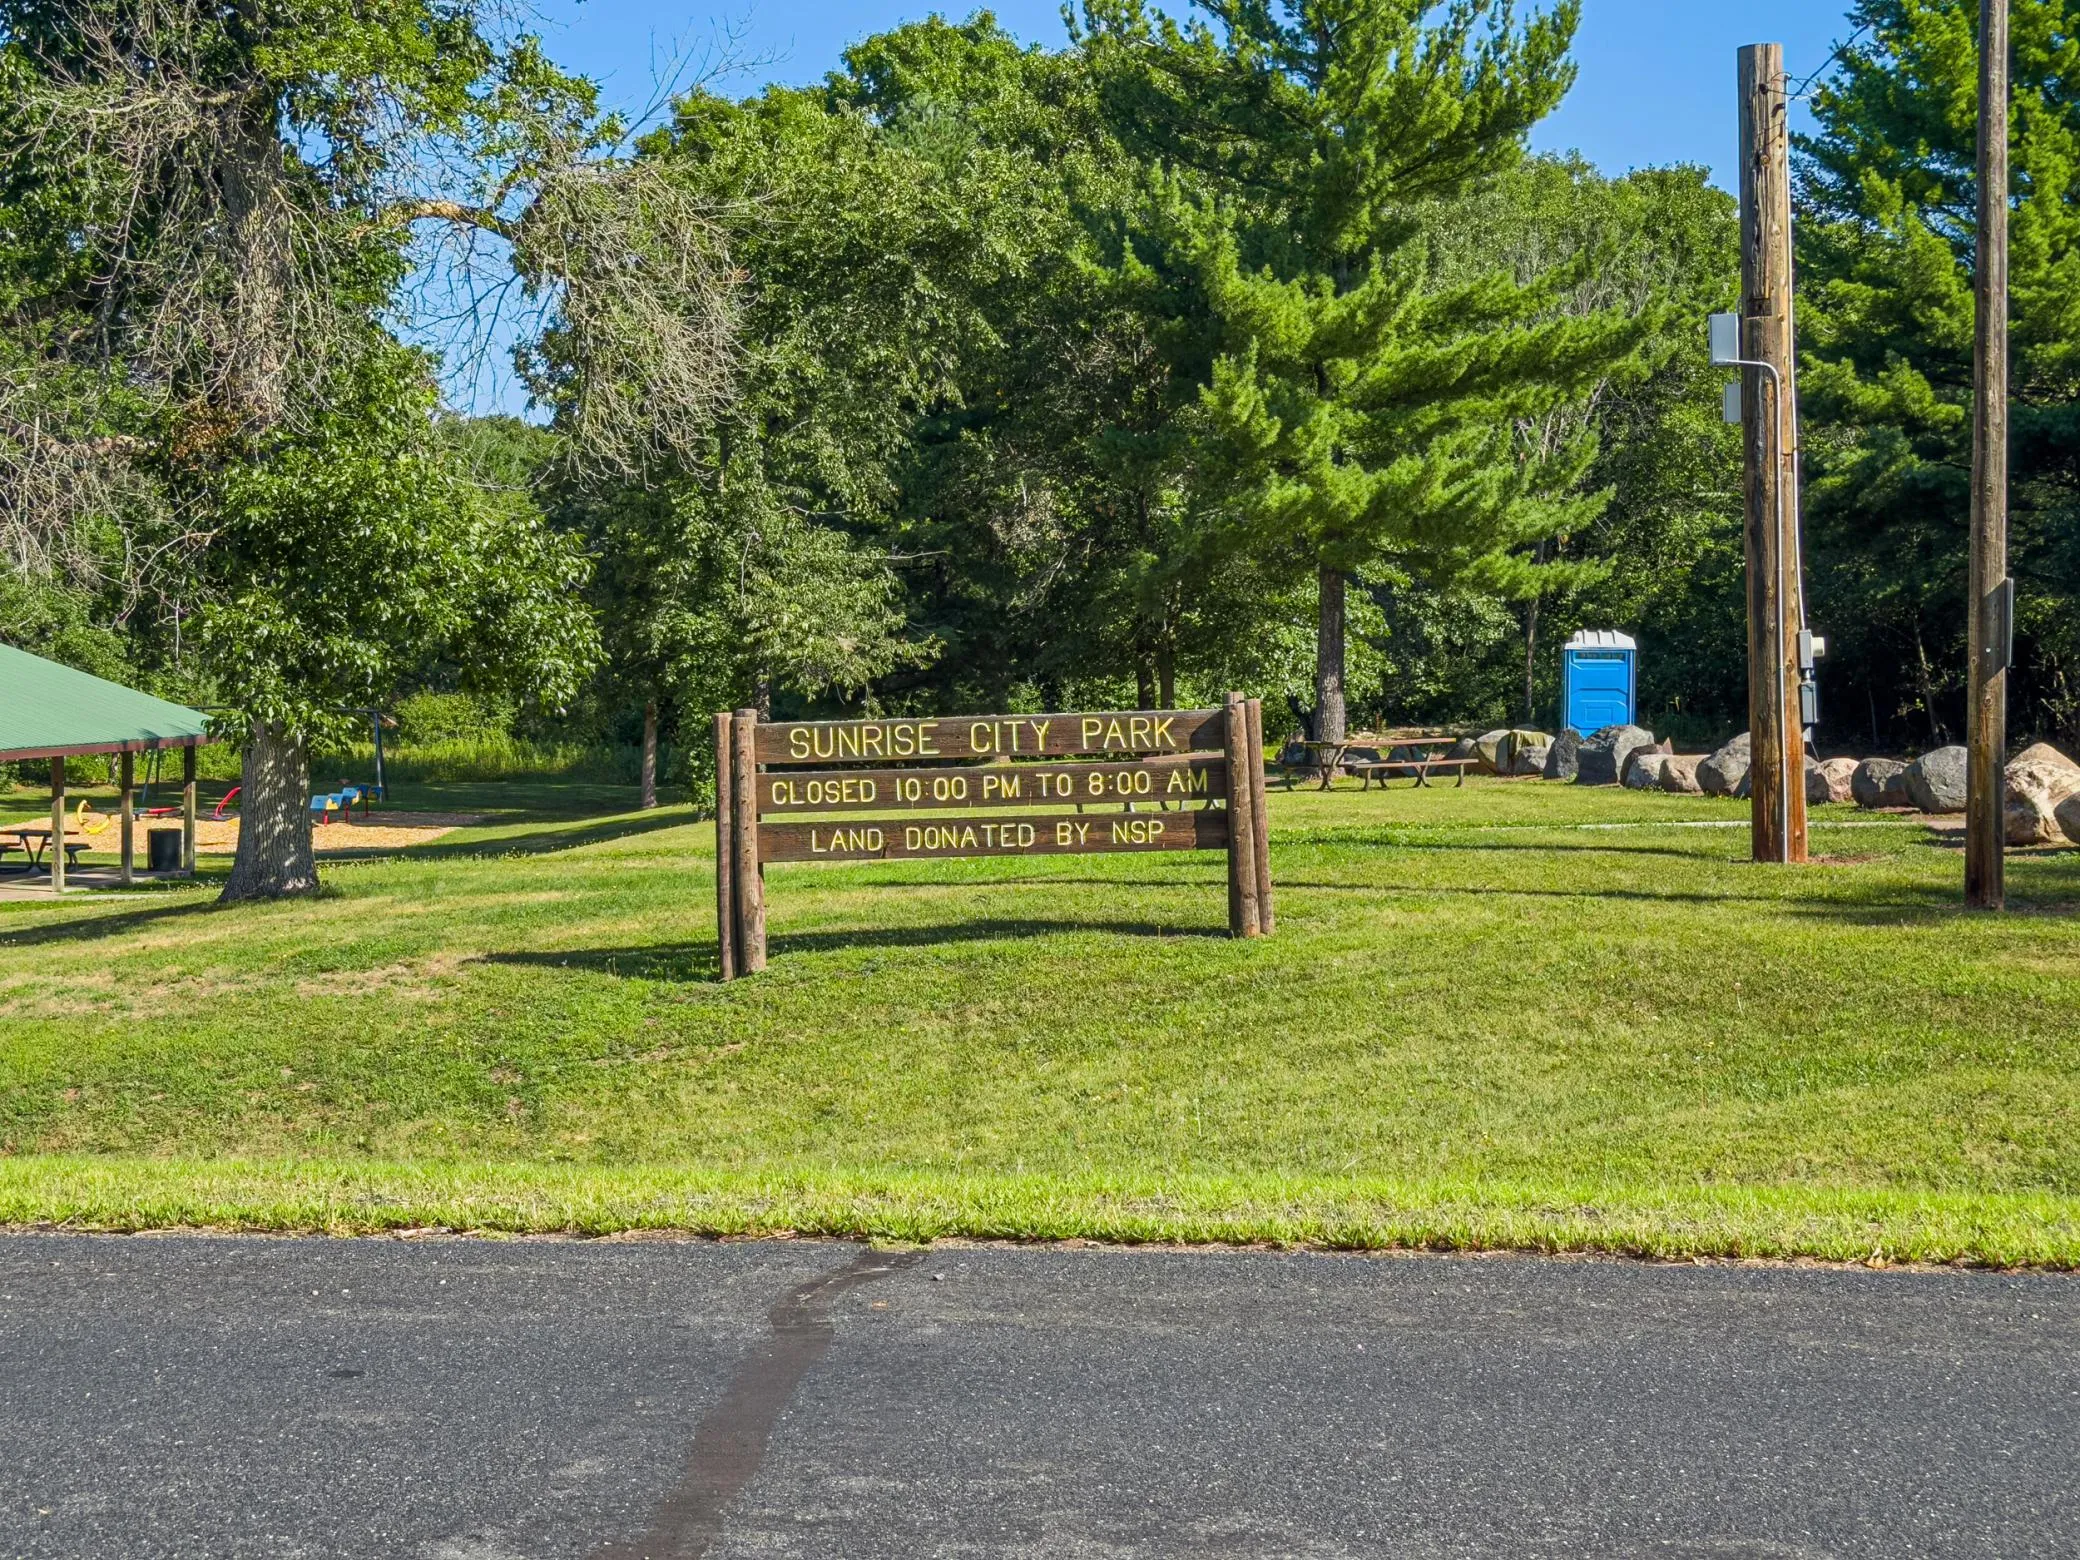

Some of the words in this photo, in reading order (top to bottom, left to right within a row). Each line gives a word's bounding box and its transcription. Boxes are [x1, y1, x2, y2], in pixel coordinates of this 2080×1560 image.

[789, 723, 941, 759] SUNRISE
[970, 719, 1051, 753] CITY
[1081, 716, 1177, 749] PARK
[772, 779, 876, 805] CLOSED
[896, 776, 967, 801] 10:00
[983, 774, 1021, 799] PM
[1037, 772, 1073, 797] TO
[1088, 770, 1151, 795] 8:00
[1166, 768, 1208, 793] AM
[811, 829, 884, 853] LAND
[906, 823, 1036, 851] DONATED
[1056, 821, 1091, 845] BY
[1112, 820, 1166, 844] NSP
